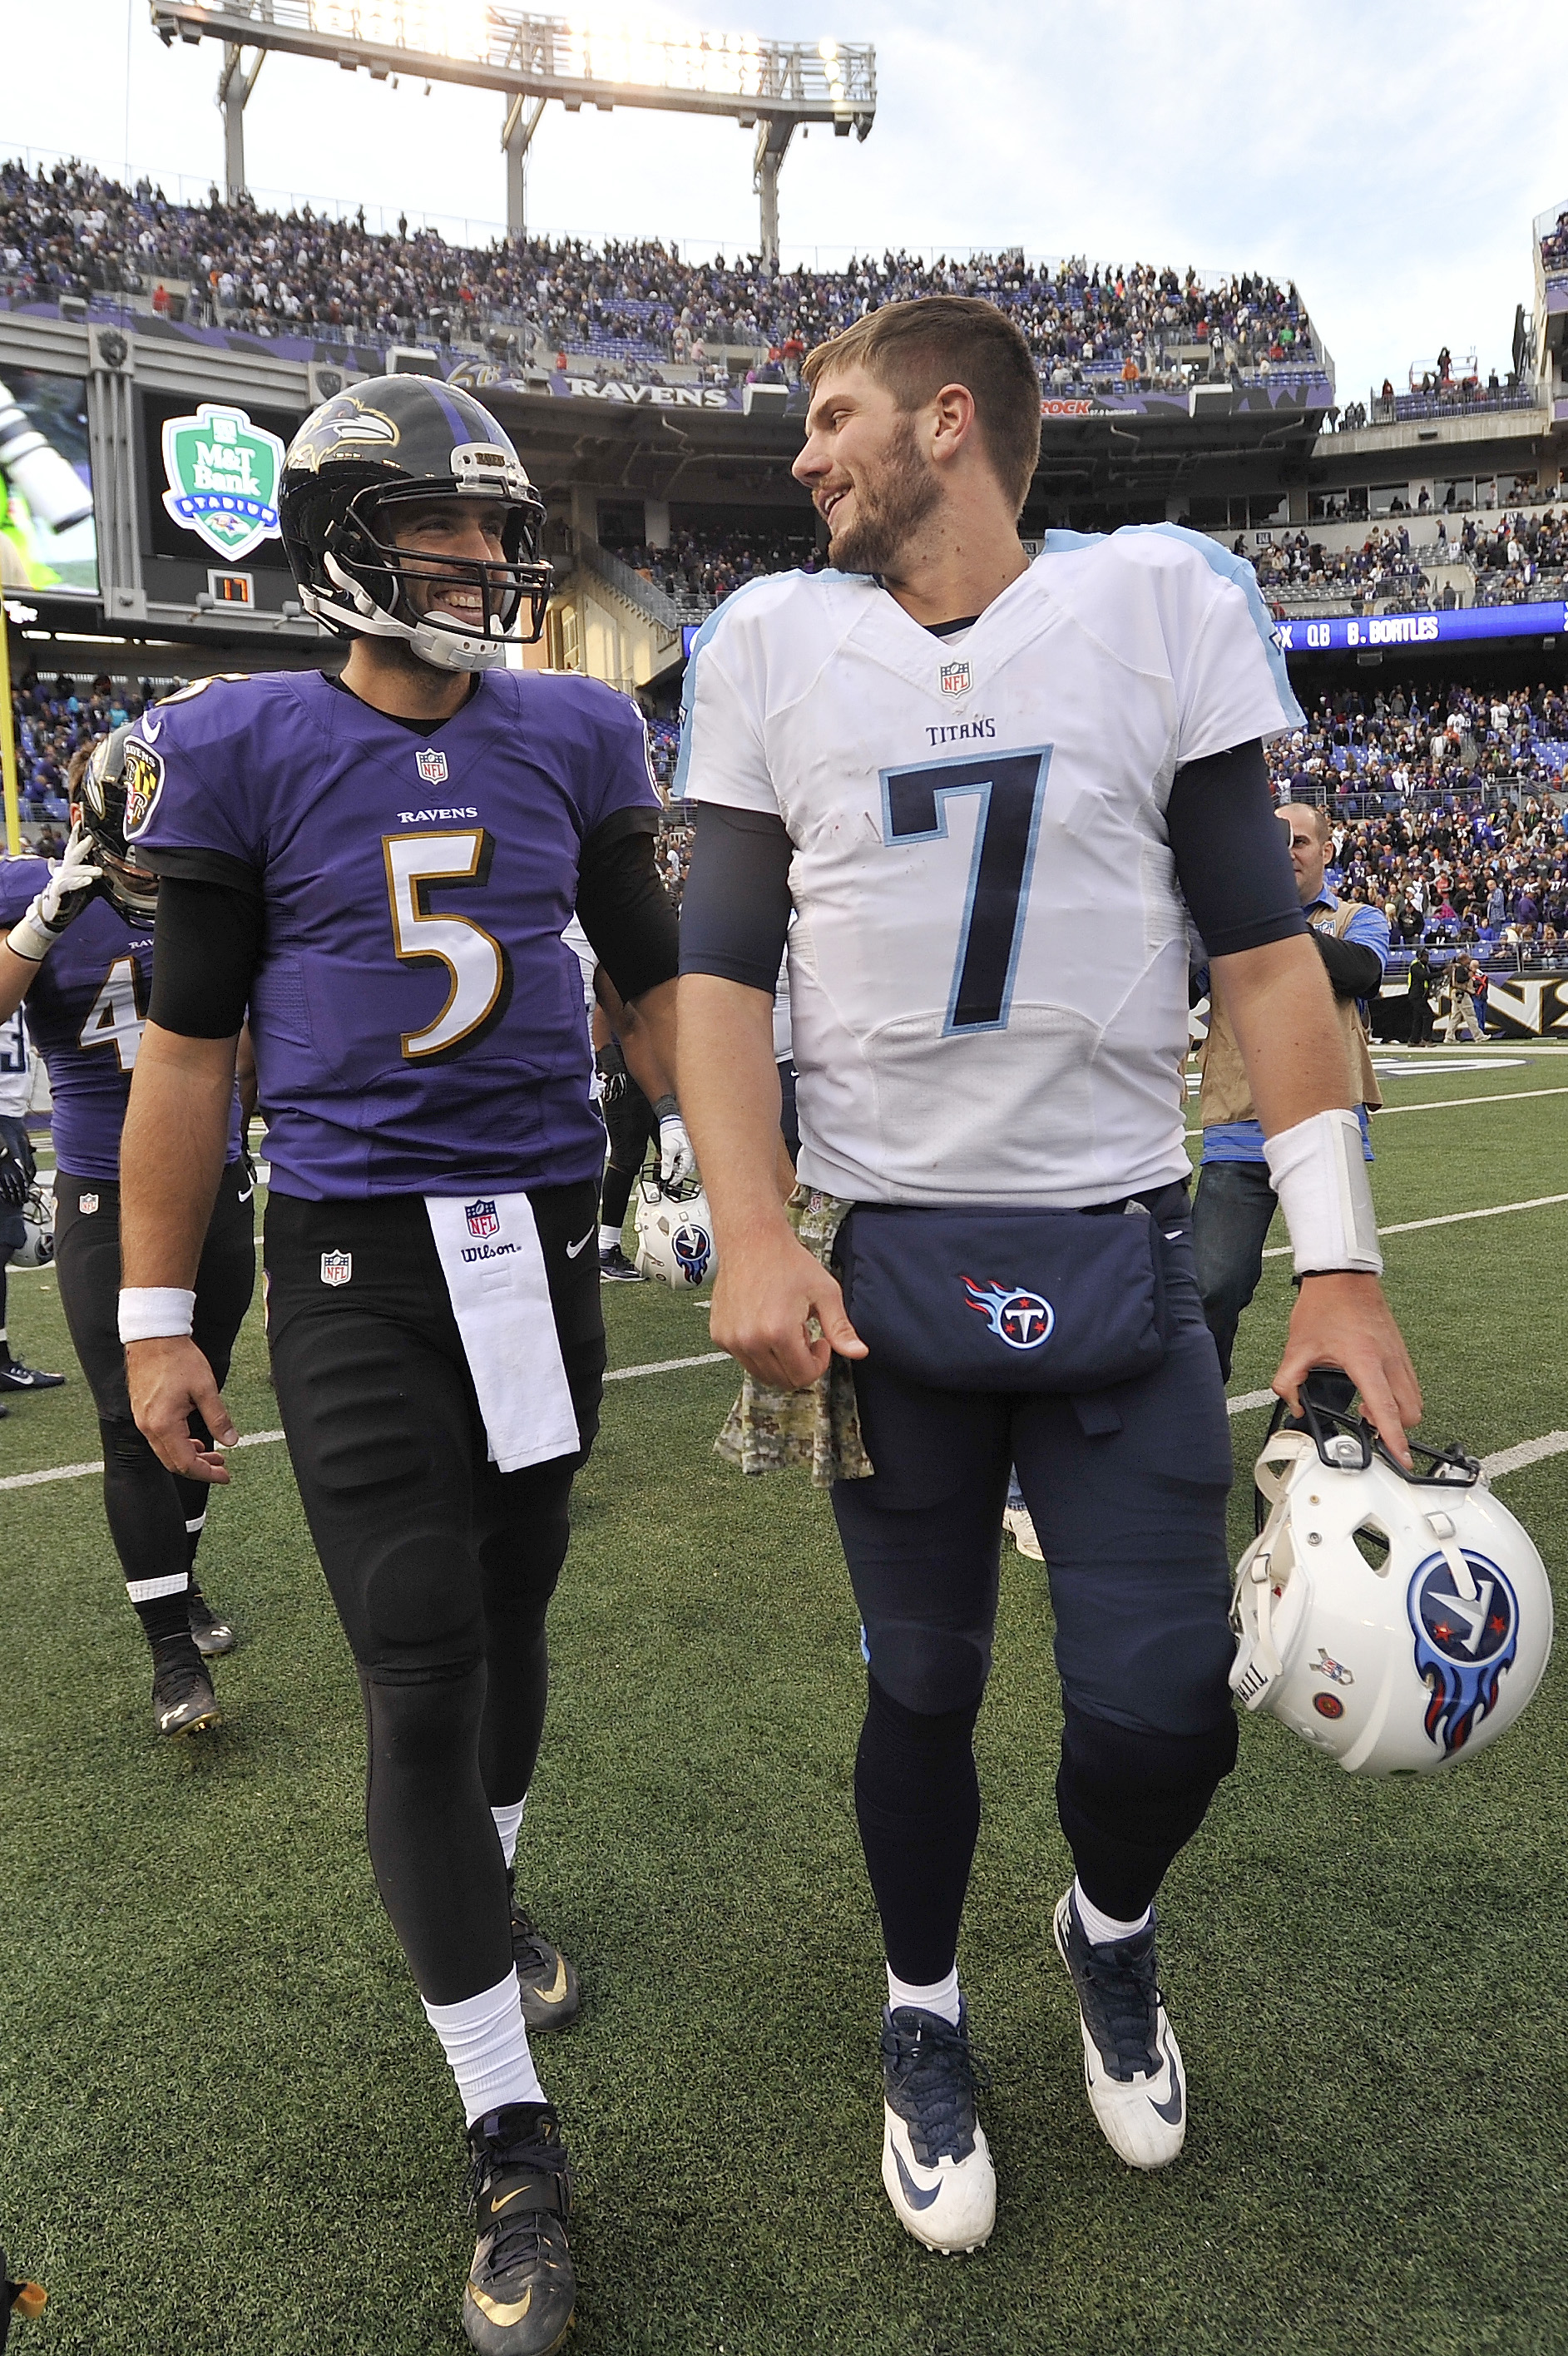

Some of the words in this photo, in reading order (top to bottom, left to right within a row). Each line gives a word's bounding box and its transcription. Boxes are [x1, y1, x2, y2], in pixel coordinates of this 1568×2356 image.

[565, 377, 728, 408] RAVENS
[195, 440, 256, 472] M&T
[193, 463, 262, 497] Bank
[181, 497, 275, 523] STADIUM
[224, 578, 248, 602] 17
[1307, 623, 1330, 647] QB
[943, 674, 967, 692] NFL
[925, 717, 997, 747] TITANS
[423, 764, 444, 778] NFL
[397, 806, 478, 824] RAVENS
[878, 742, 1055, 1038] 7
[128, 938, 154, 949] RAV
[382, 827, 510, 1063] 5
[77, 956, 149, 1074] 4
[469, 1215, 497, 1235] NFL
[461, 1242, 516, 1263] Wilson
[327, 1266, 347, 1280] NFL
